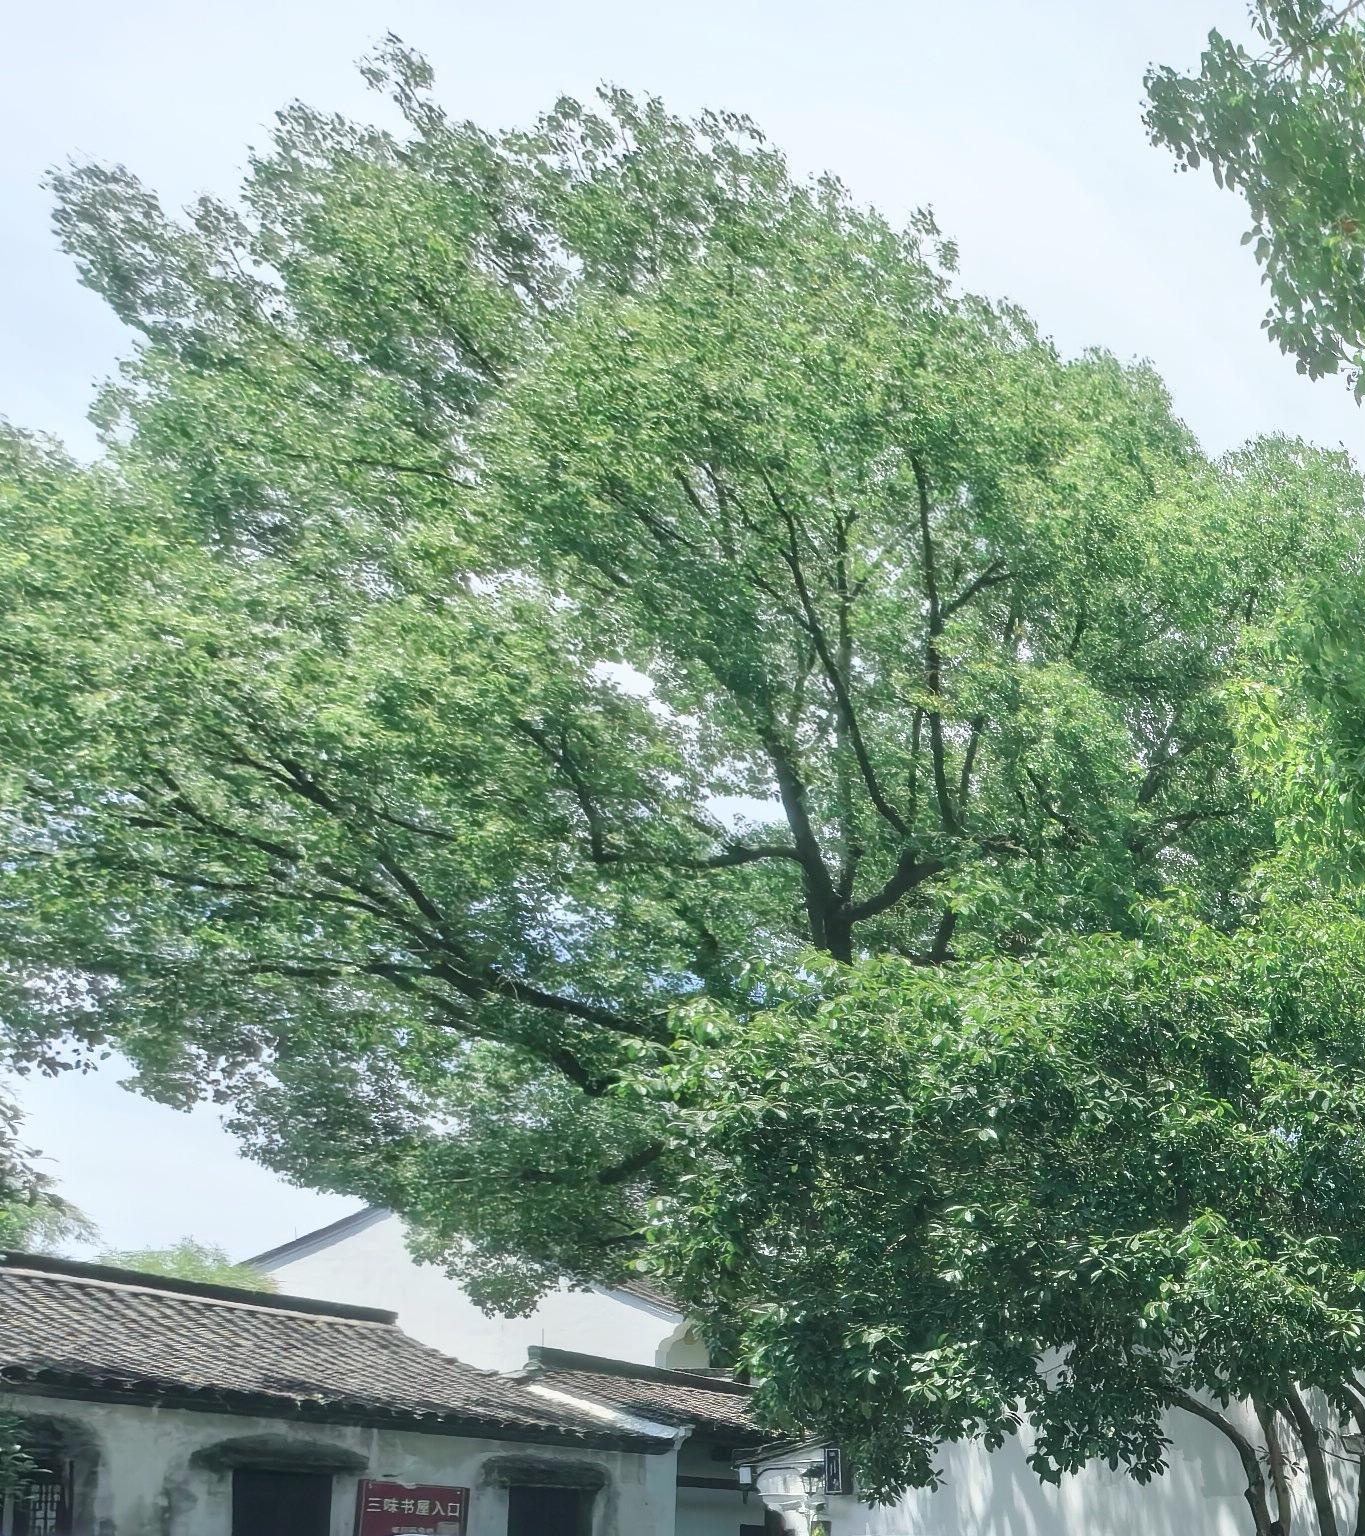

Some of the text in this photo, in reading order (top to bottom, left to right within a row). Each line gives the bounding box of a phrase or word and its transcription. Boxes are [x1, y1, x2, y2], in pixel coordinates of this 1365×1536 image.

[366, 1498, 460, 1517] 三味书屋入口
